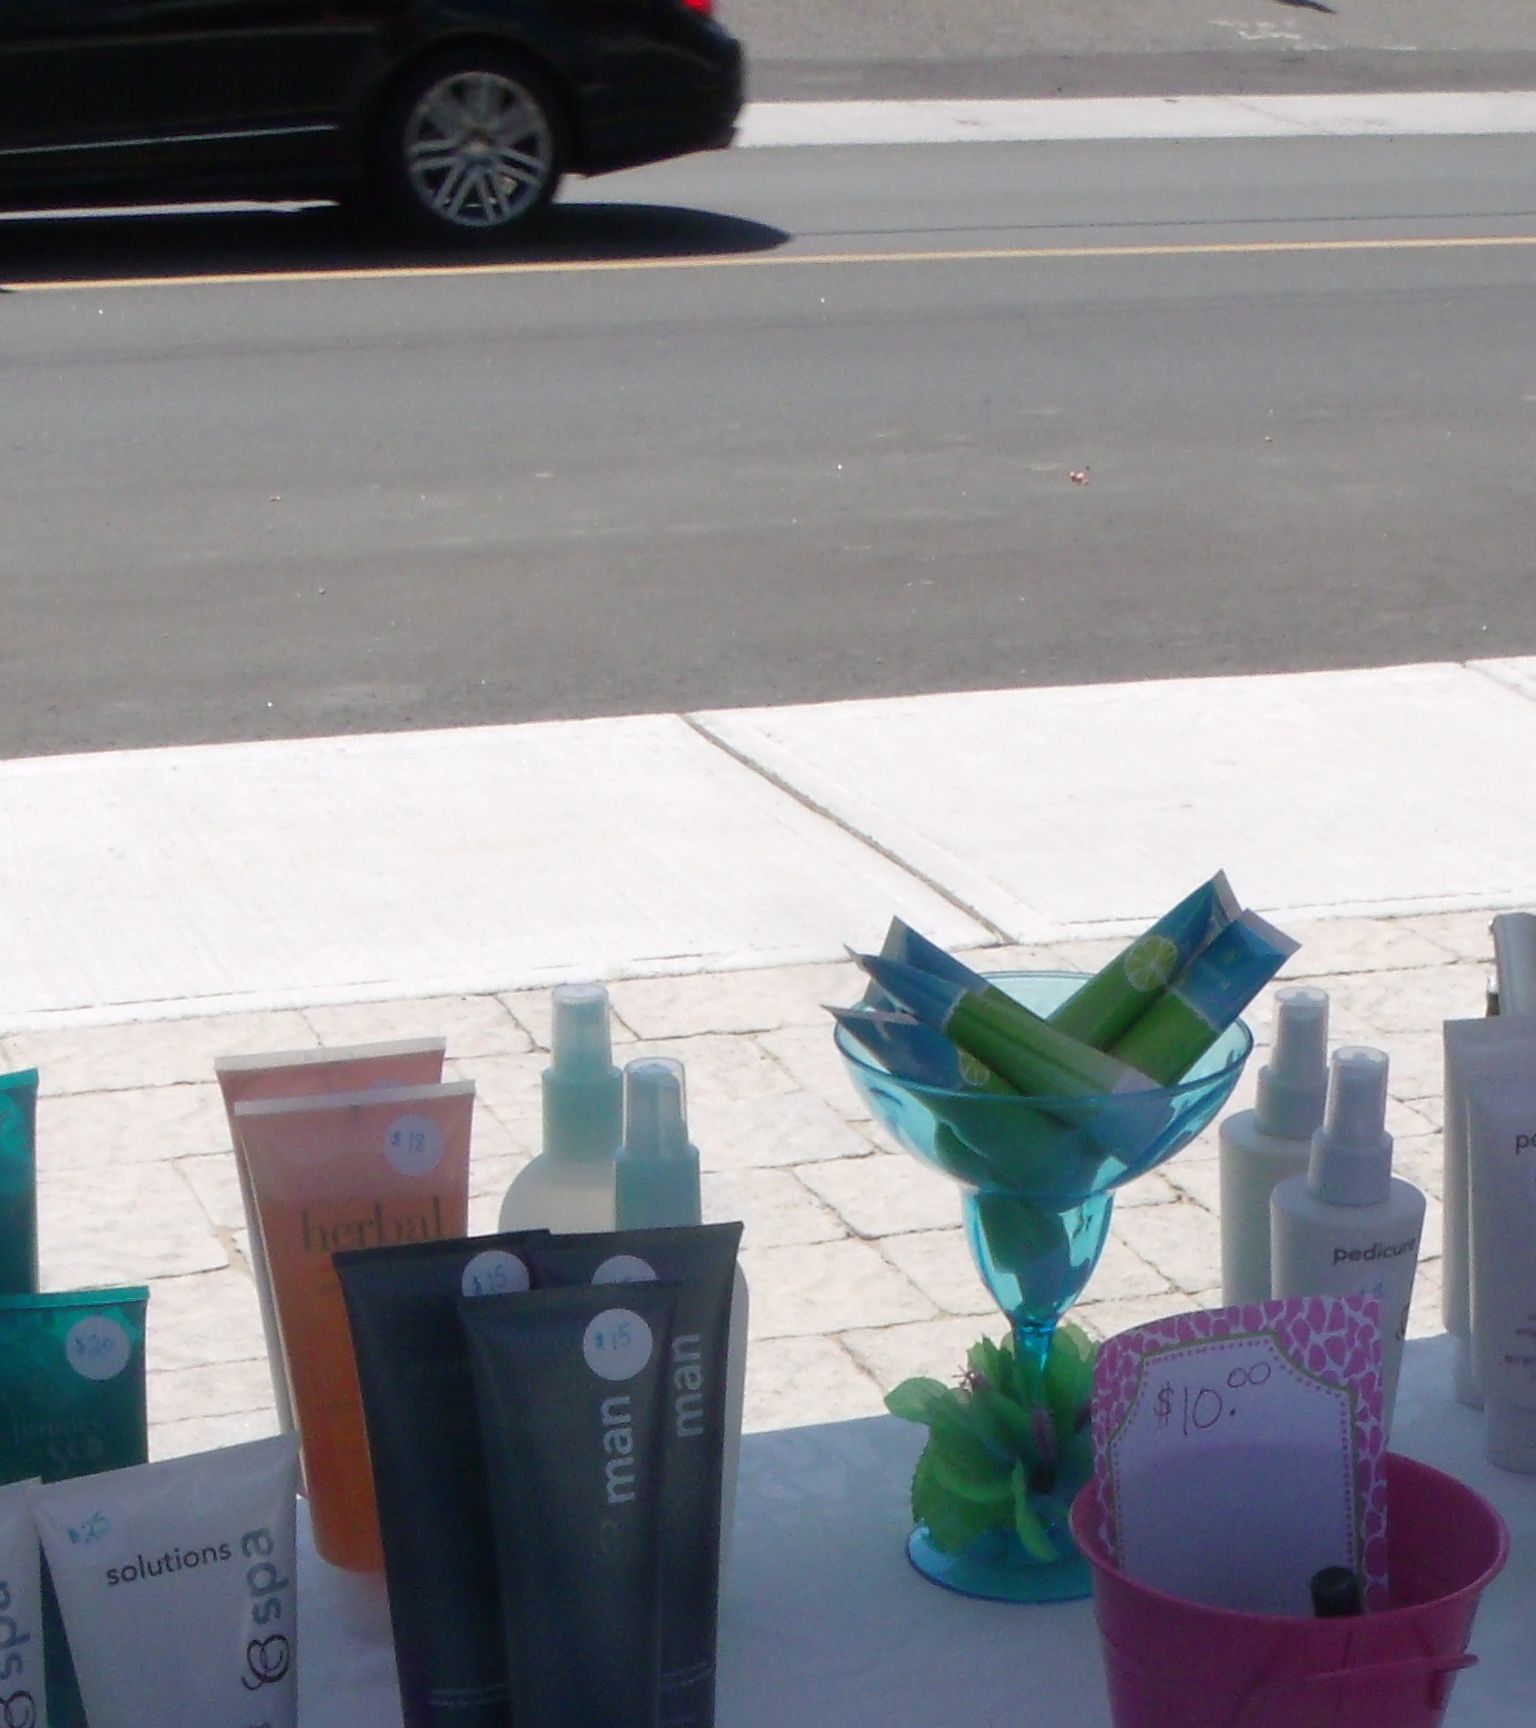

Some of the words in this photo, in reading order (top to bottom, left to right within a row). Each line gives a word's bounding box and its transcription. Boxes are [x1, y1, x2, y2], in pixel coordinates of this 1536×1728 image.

[301, 1195, 442, 1251] herbal
[1333, 1239, 1416, 1265] pedicur
[672, 1333, 704, 1438] man
[600, 1396, 636, 1504] man
[106, 1542, 232, 1587] solutions
[241, 1527, 289, 1625] spa
